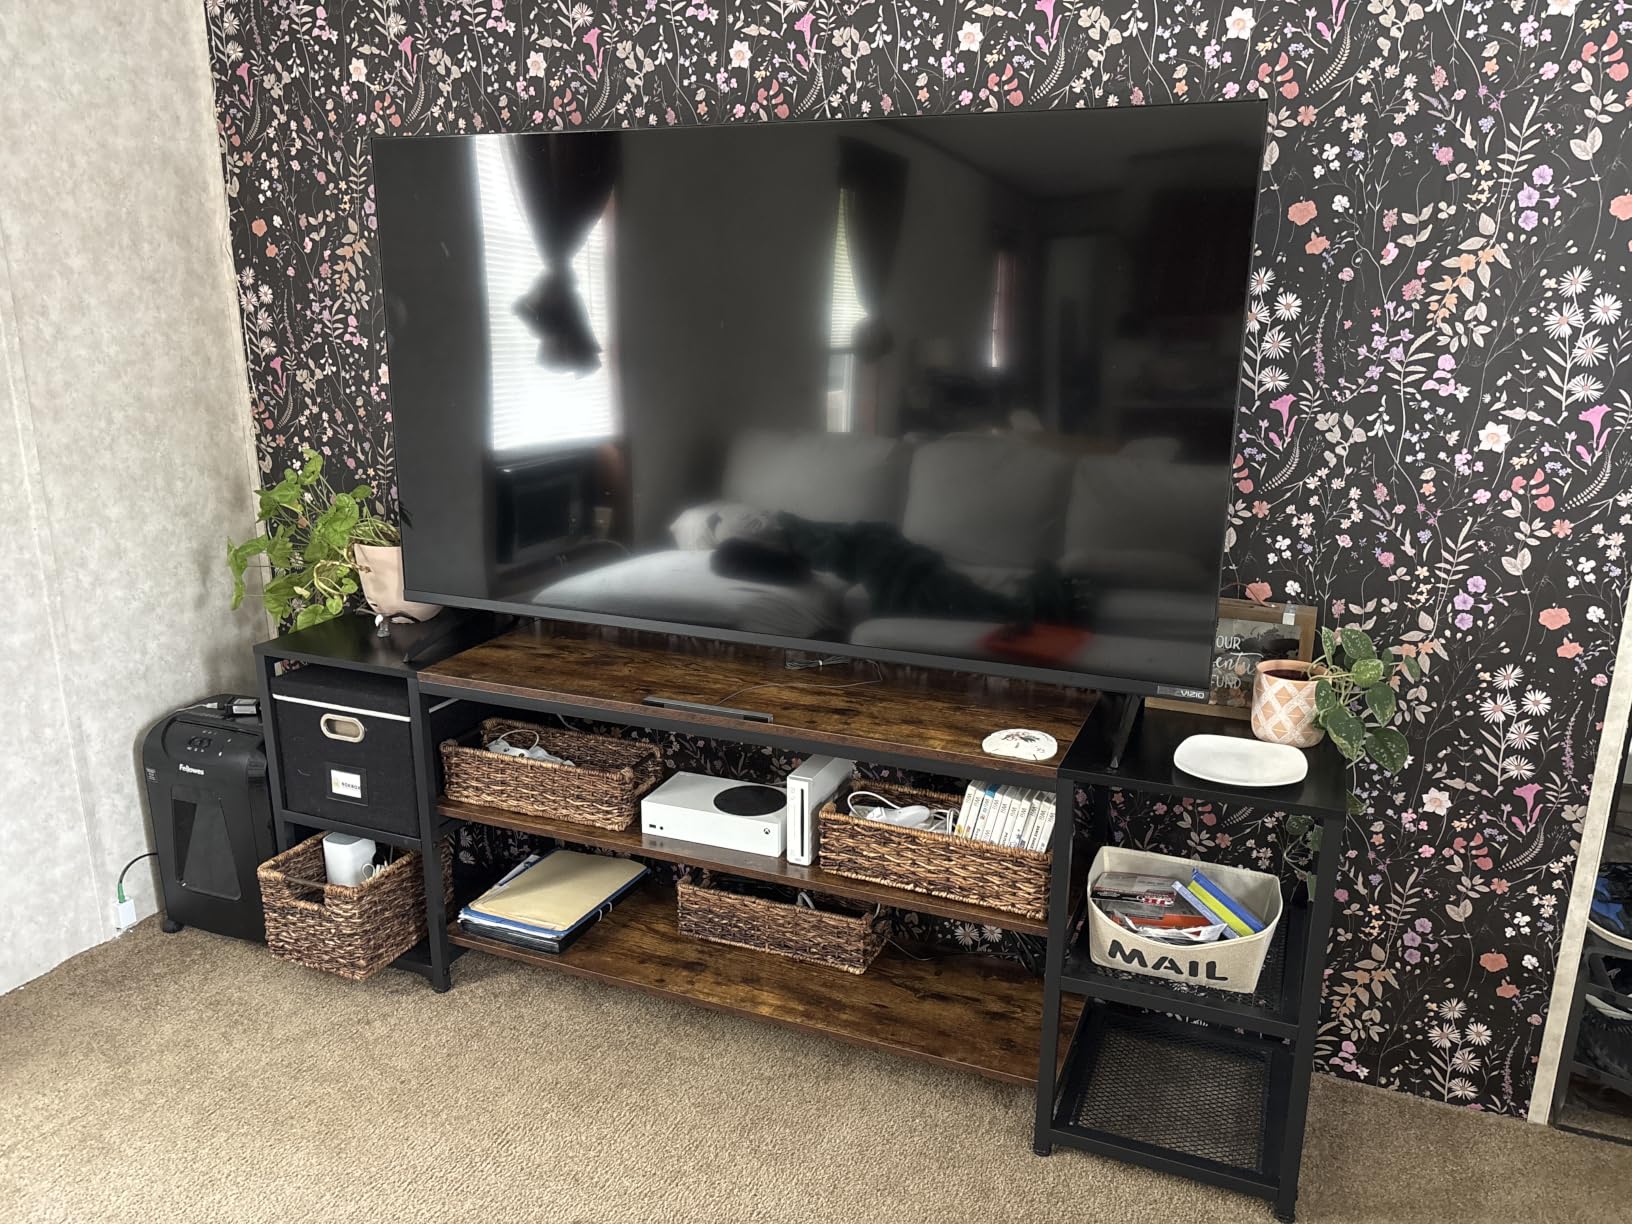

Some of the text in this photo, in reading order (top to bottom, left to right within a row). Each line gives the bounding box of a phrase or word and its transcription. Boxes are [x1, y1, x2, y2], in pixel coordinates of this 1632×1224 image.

[1216, 635, 1241, 650] OUR
[1180, 690, 1205, 699] VIZIO
[179, 763, 205, 776] Fellowes
[1108, 939, 1229, 983] MAIL
